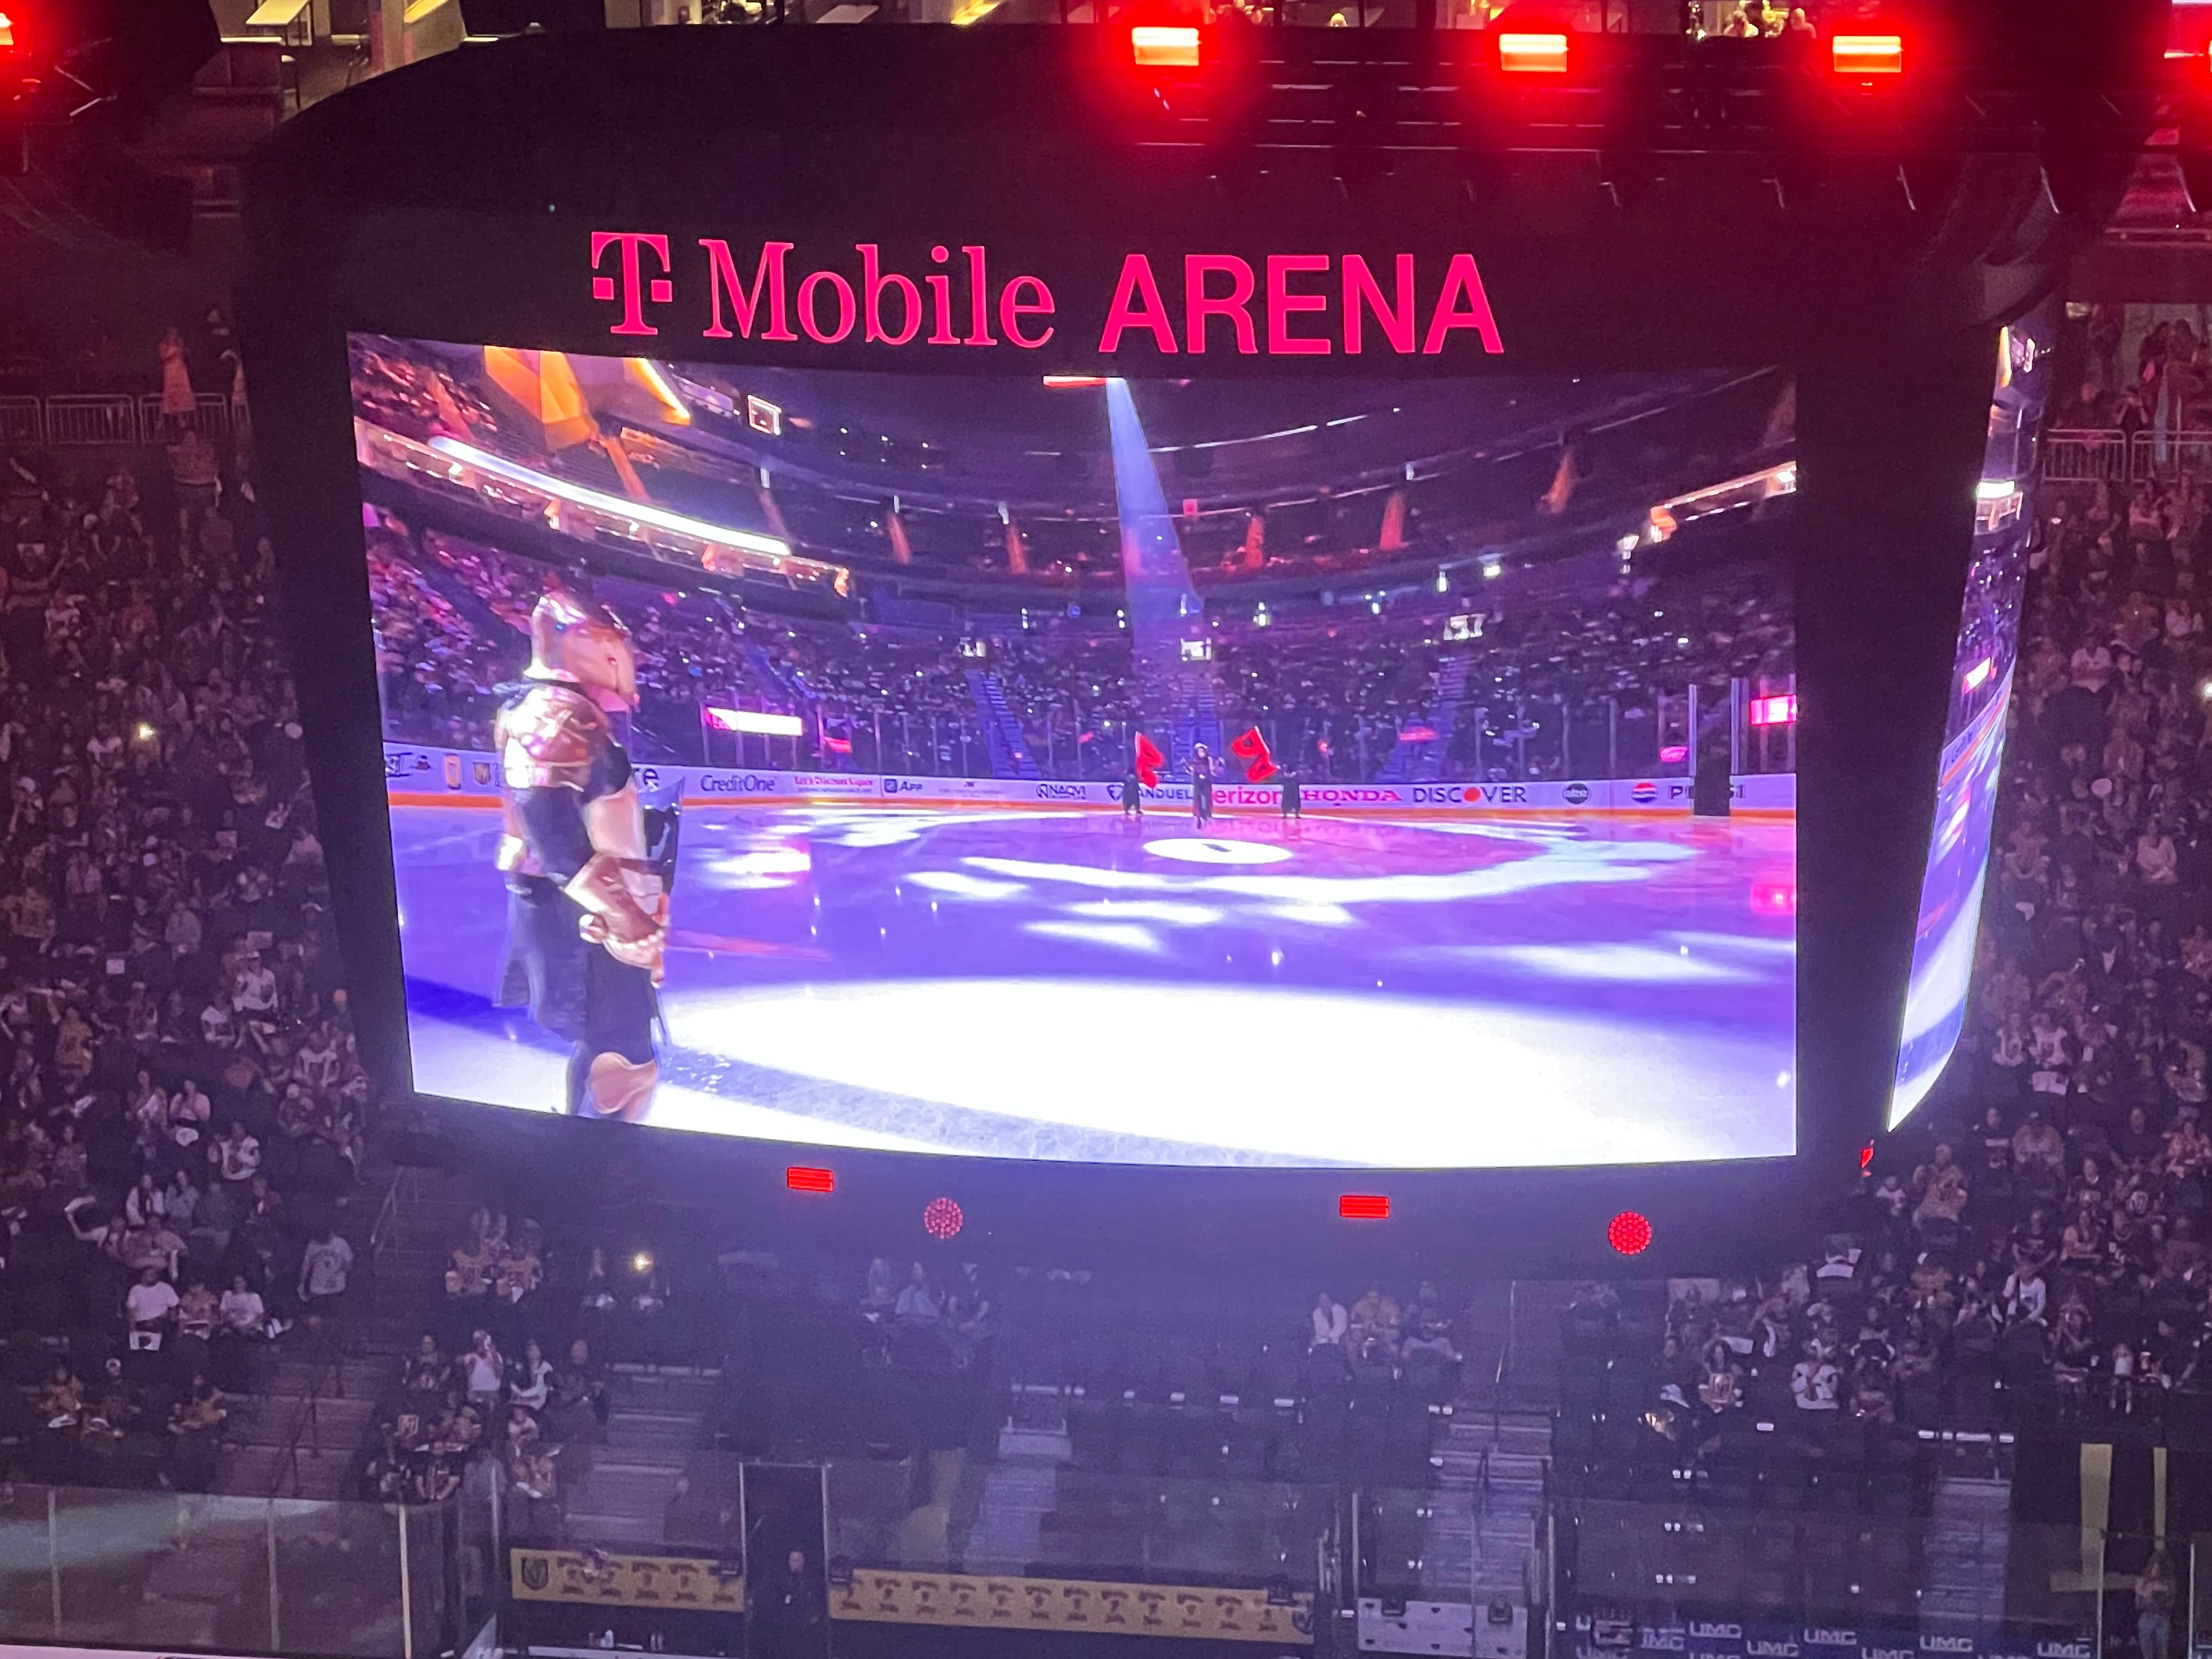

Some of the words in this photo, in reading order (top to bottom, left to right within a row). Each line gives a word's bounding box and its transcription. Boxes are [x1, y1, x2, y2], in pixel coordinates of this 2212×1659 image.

[698, 240, 1056, 349] Mobile
[1098, 253, 1505, 355] ARENA
[1138, 788, 1193, 799] ANDUEL
[1301, 790, 1402, 802] HONDA
[1413, 786, 1527, 803] DISCOVER
